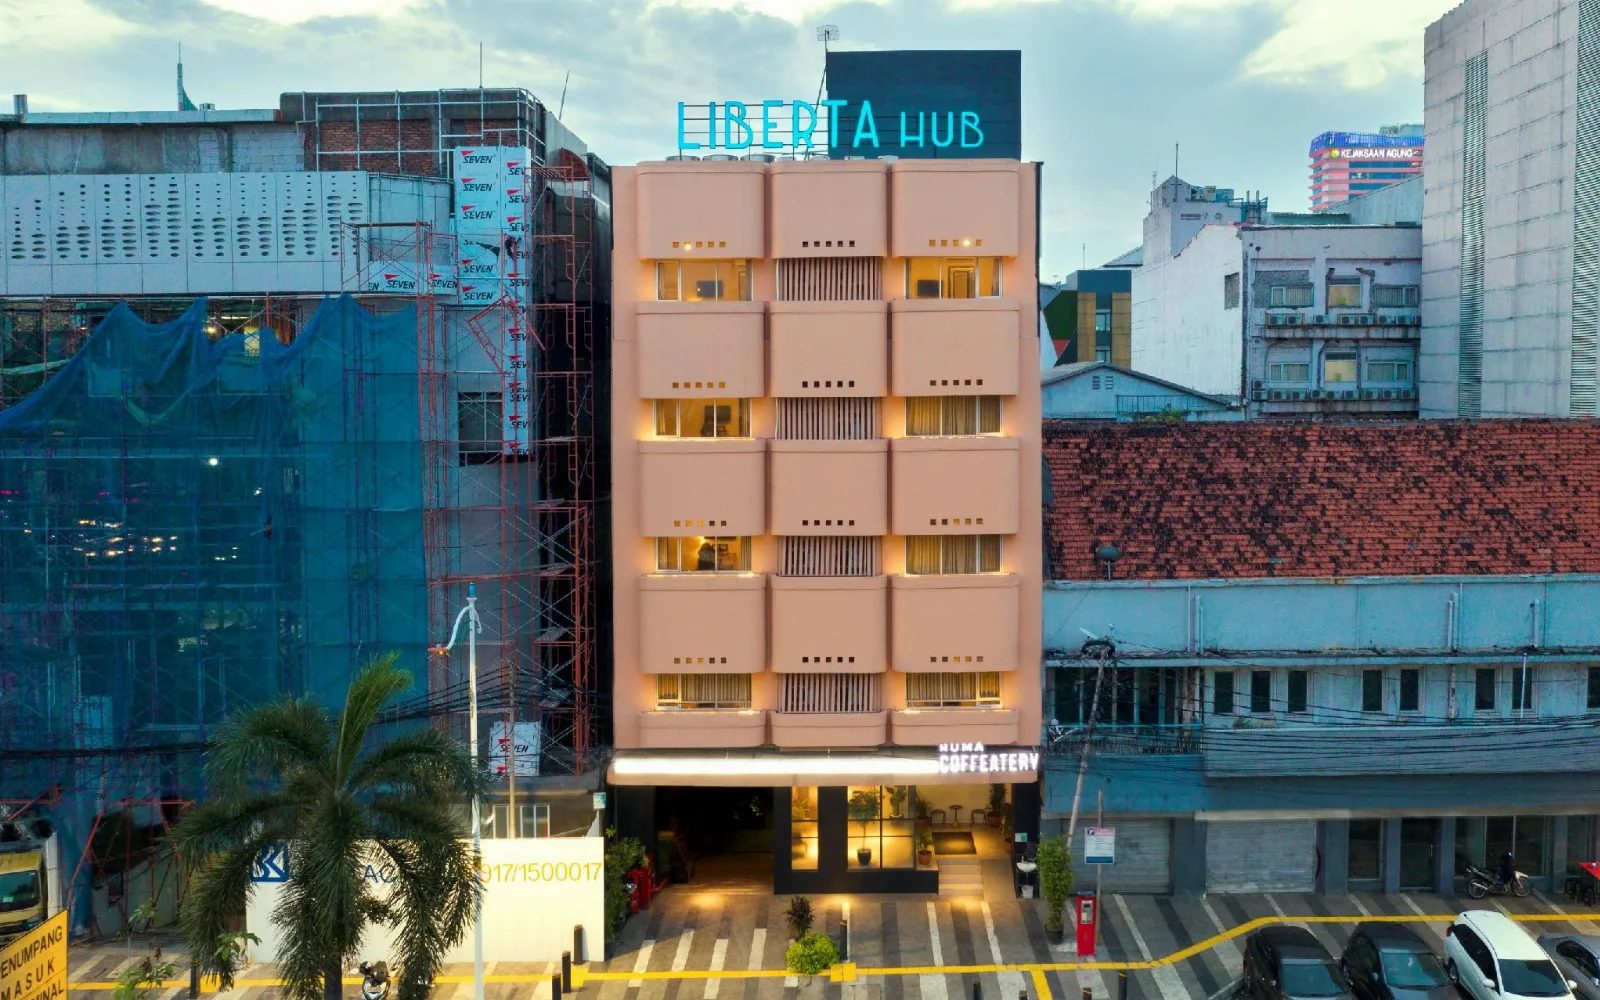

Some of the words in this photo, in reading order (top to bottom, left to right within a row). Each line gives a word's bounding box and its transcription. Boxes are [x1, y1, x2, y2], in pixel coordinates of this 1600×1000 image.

[678, 100, 879, 149] LIBERTA
[900, 111, 984, 148] HUB
[1341, 149, 1385, 158] KEJAKSAAN
[1386, 149, 1413, 158] AGUNG
[463, 155, 493, 164] SEVEN
[463, 183, 493, 192] SEVEN
[463, 210, 493, 219] SEVEN
[464, 264, 493, 273] SEVEN
[386, 280, 415, 290] SEVEN
[431, 279, 458, 289] SEVEN
[464, 291, 494, 301] SEVEN
[0, 925, 63, 979] ENUMPANG
